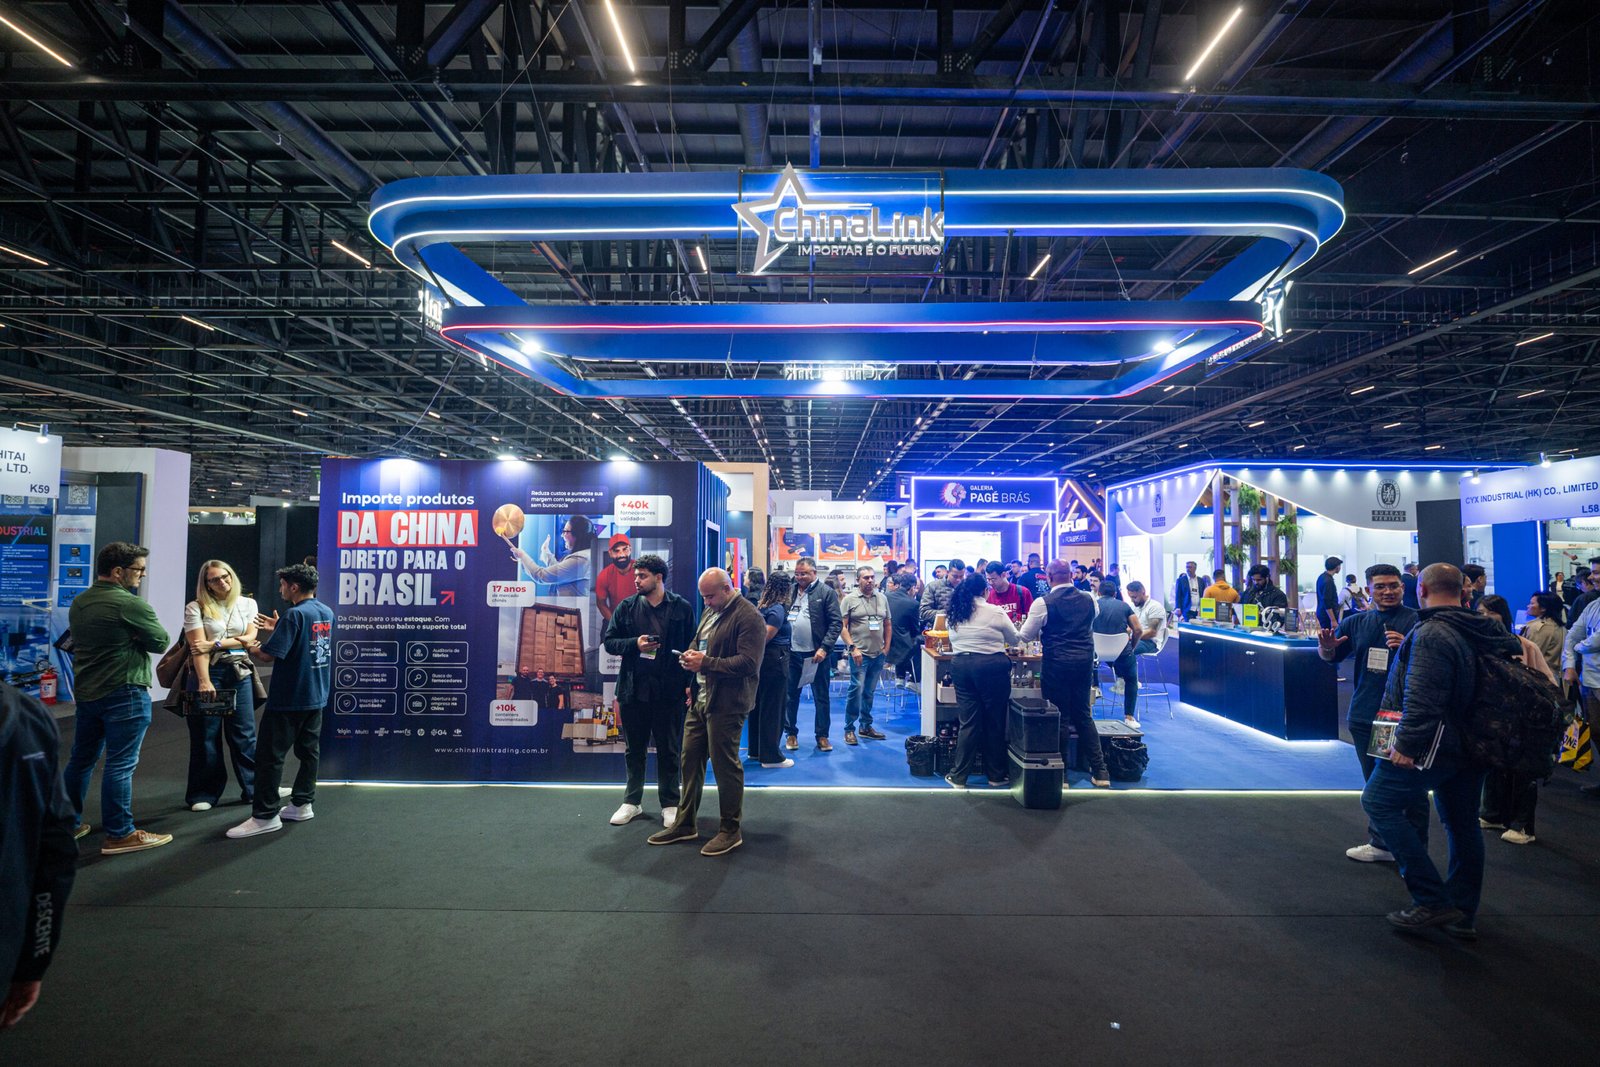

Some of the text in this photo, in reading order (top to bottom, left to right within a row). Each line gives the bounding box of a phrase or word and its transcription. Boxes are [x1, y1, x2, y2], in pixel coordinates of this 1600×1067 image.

[774, 206, 944, 241] ChinaLink
[798, 242, 942, 256] IMPORTAR É O FUTURO
[6, 463, 31, 474] LTD.
[30, 484, 50, 494] K59
[970, 490, 1030, 503] PAGÉ BRÁS
[1465, 482, 1598, 504] CYX INDUSTRIAL (HK) CO., LIMITED
[342, 492, 474, 507] Importe produtos
[621, 500, 649, 509] +40k
[1582, 504, 1599, 513] L58
[341, 512, 475, 545] DA CHINA
[340, 550, 466, 570] DIRETO PARA O
[338, 572, 436, 606] BRASIL
[34, 892, 53, 958] DESCENTE
